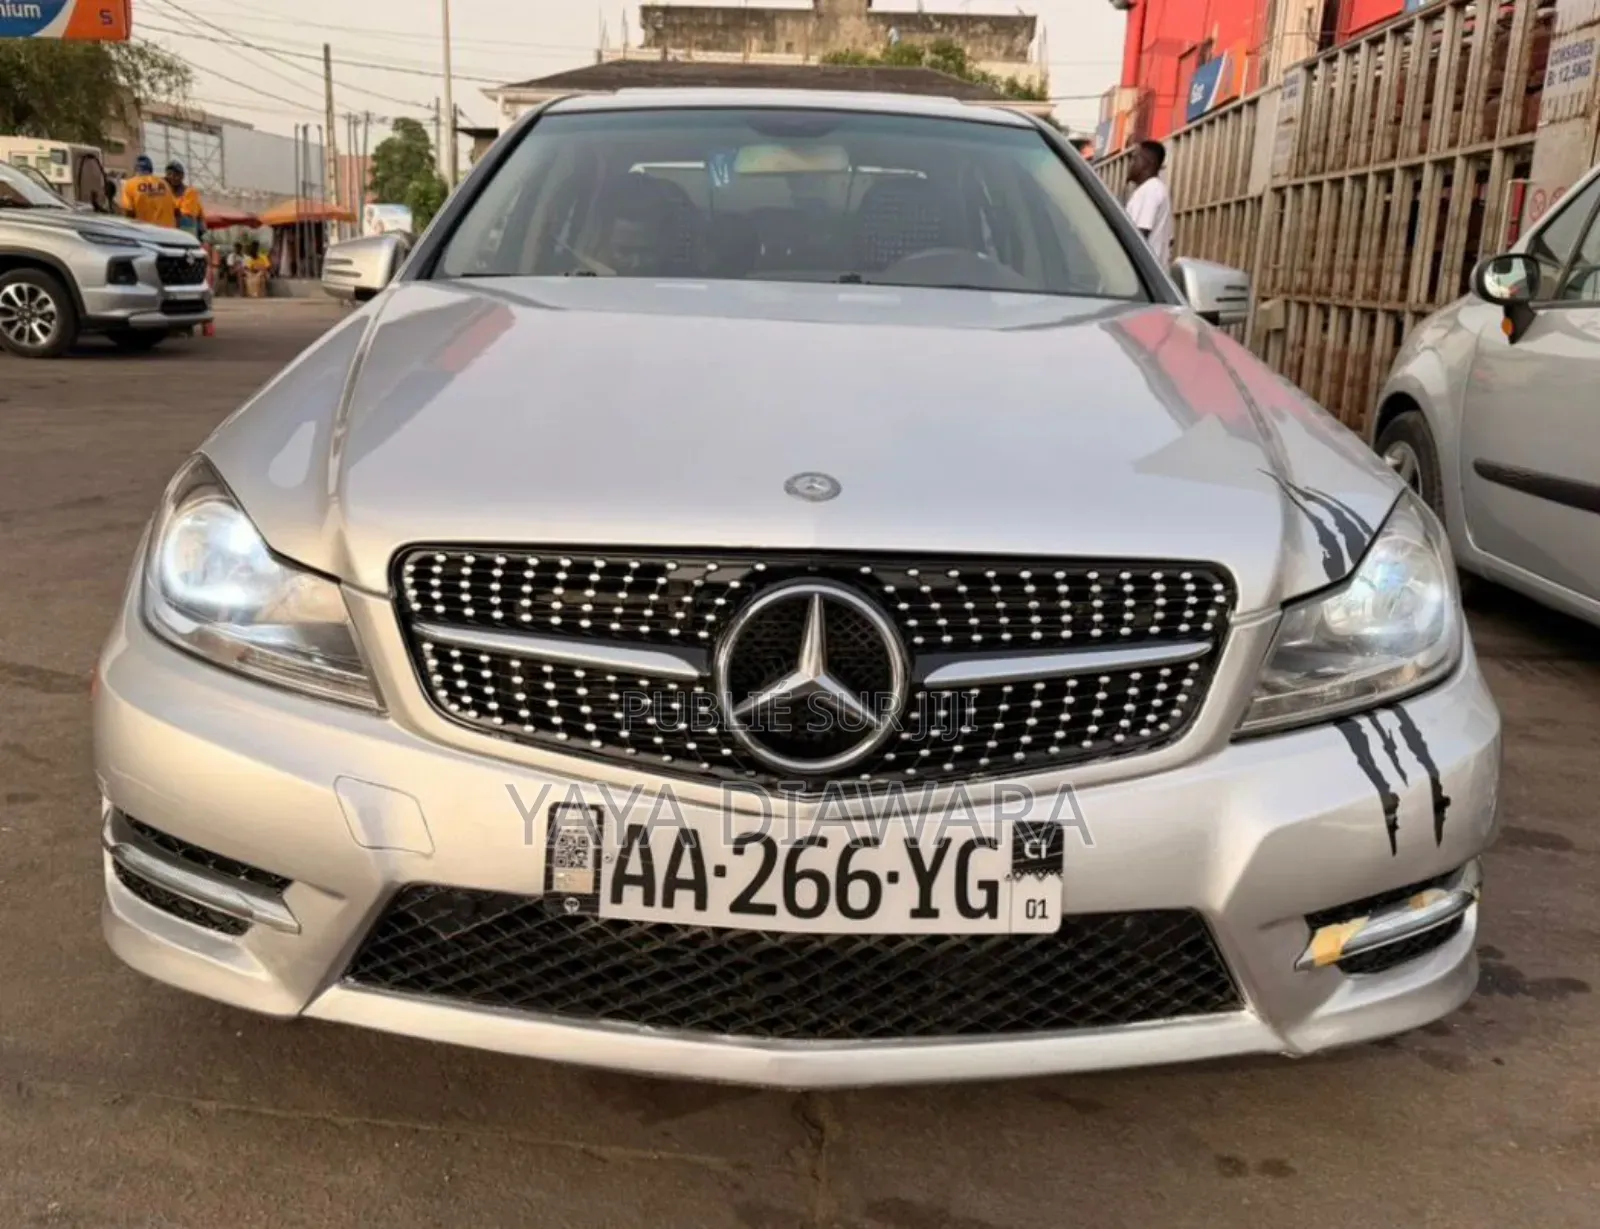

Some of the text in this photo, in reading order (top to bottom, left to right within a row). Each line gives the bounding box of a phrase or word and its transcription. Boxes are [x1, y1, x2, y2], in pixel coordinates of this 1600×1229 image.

[99, 9, 113, 25] S
[1024, 839, 1047, 859] CI
[1025, 898, 1048, 919] 01
